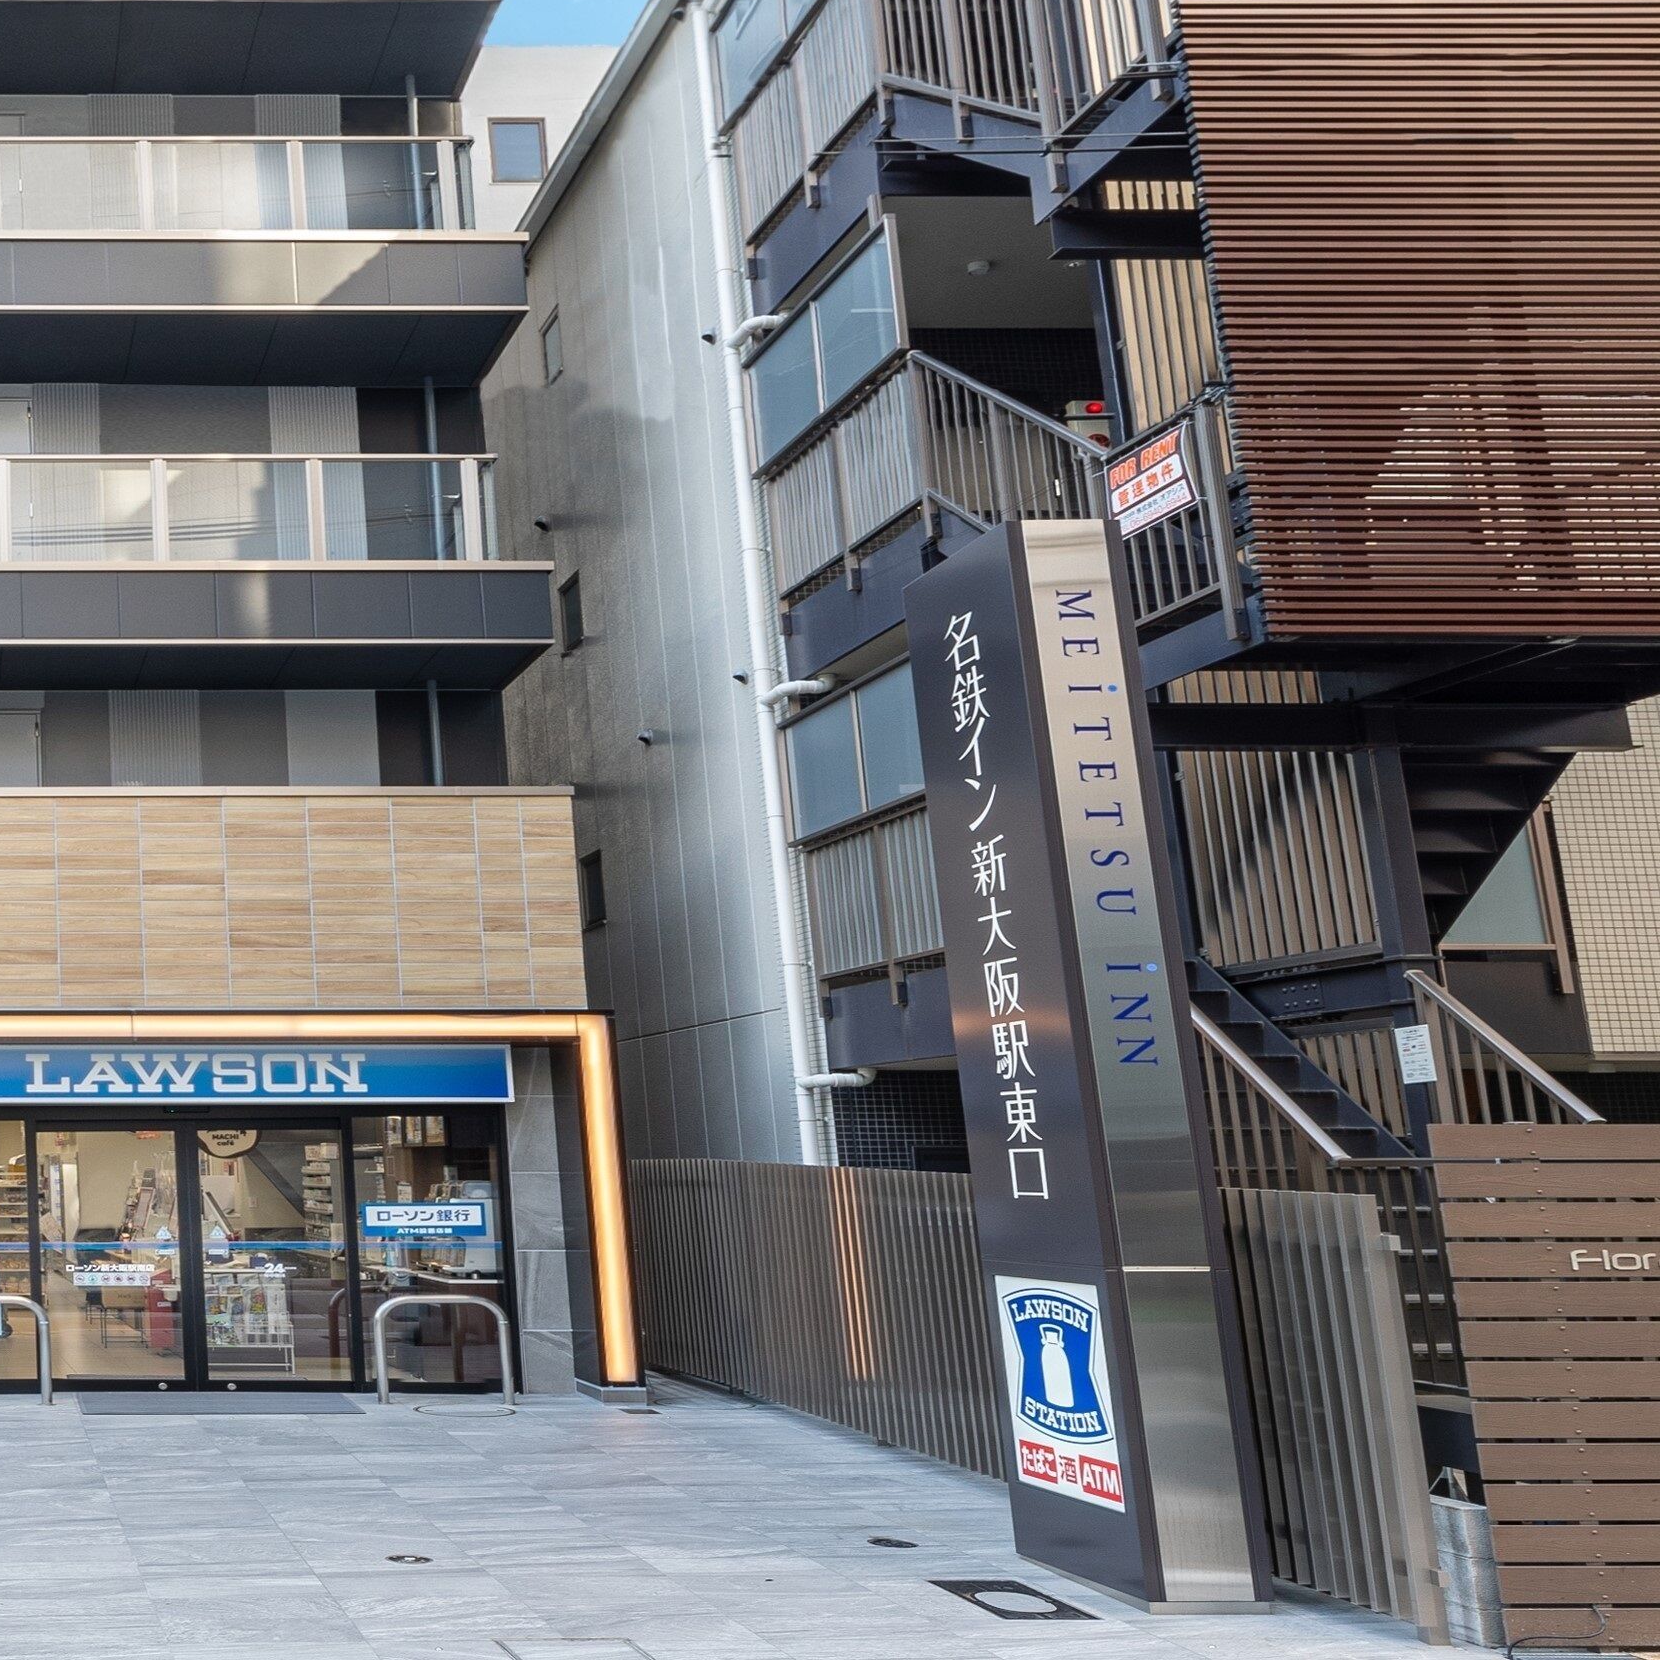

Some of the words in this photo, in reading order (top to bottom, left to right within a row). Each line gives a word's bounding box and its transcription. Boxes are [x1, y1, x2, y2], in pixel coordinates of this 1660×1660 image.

[1109, 456, 1137, 490] FOR
[1140, 429, 1180, 471] RENT
[942, 610, 1049, 1200] 名鉄イン新大阪駅東口
[24, 1053, 369, 1093] LAWSON
[376, 1209, 471, 1222] ローソン銀行
[264, 1262, 286, 1274] 24
[1570, 1248, 1660, 1271] Flor
[1011, 1298, 1090, 1333] LAWSON
[1024, 1396, 1103, 1433] STATION
[1020, 1445, 1058, 1478] たばこ
[1058, 1453, 1079, 1485] 酒
[1081, 1462, 1121, 1496] ATM
